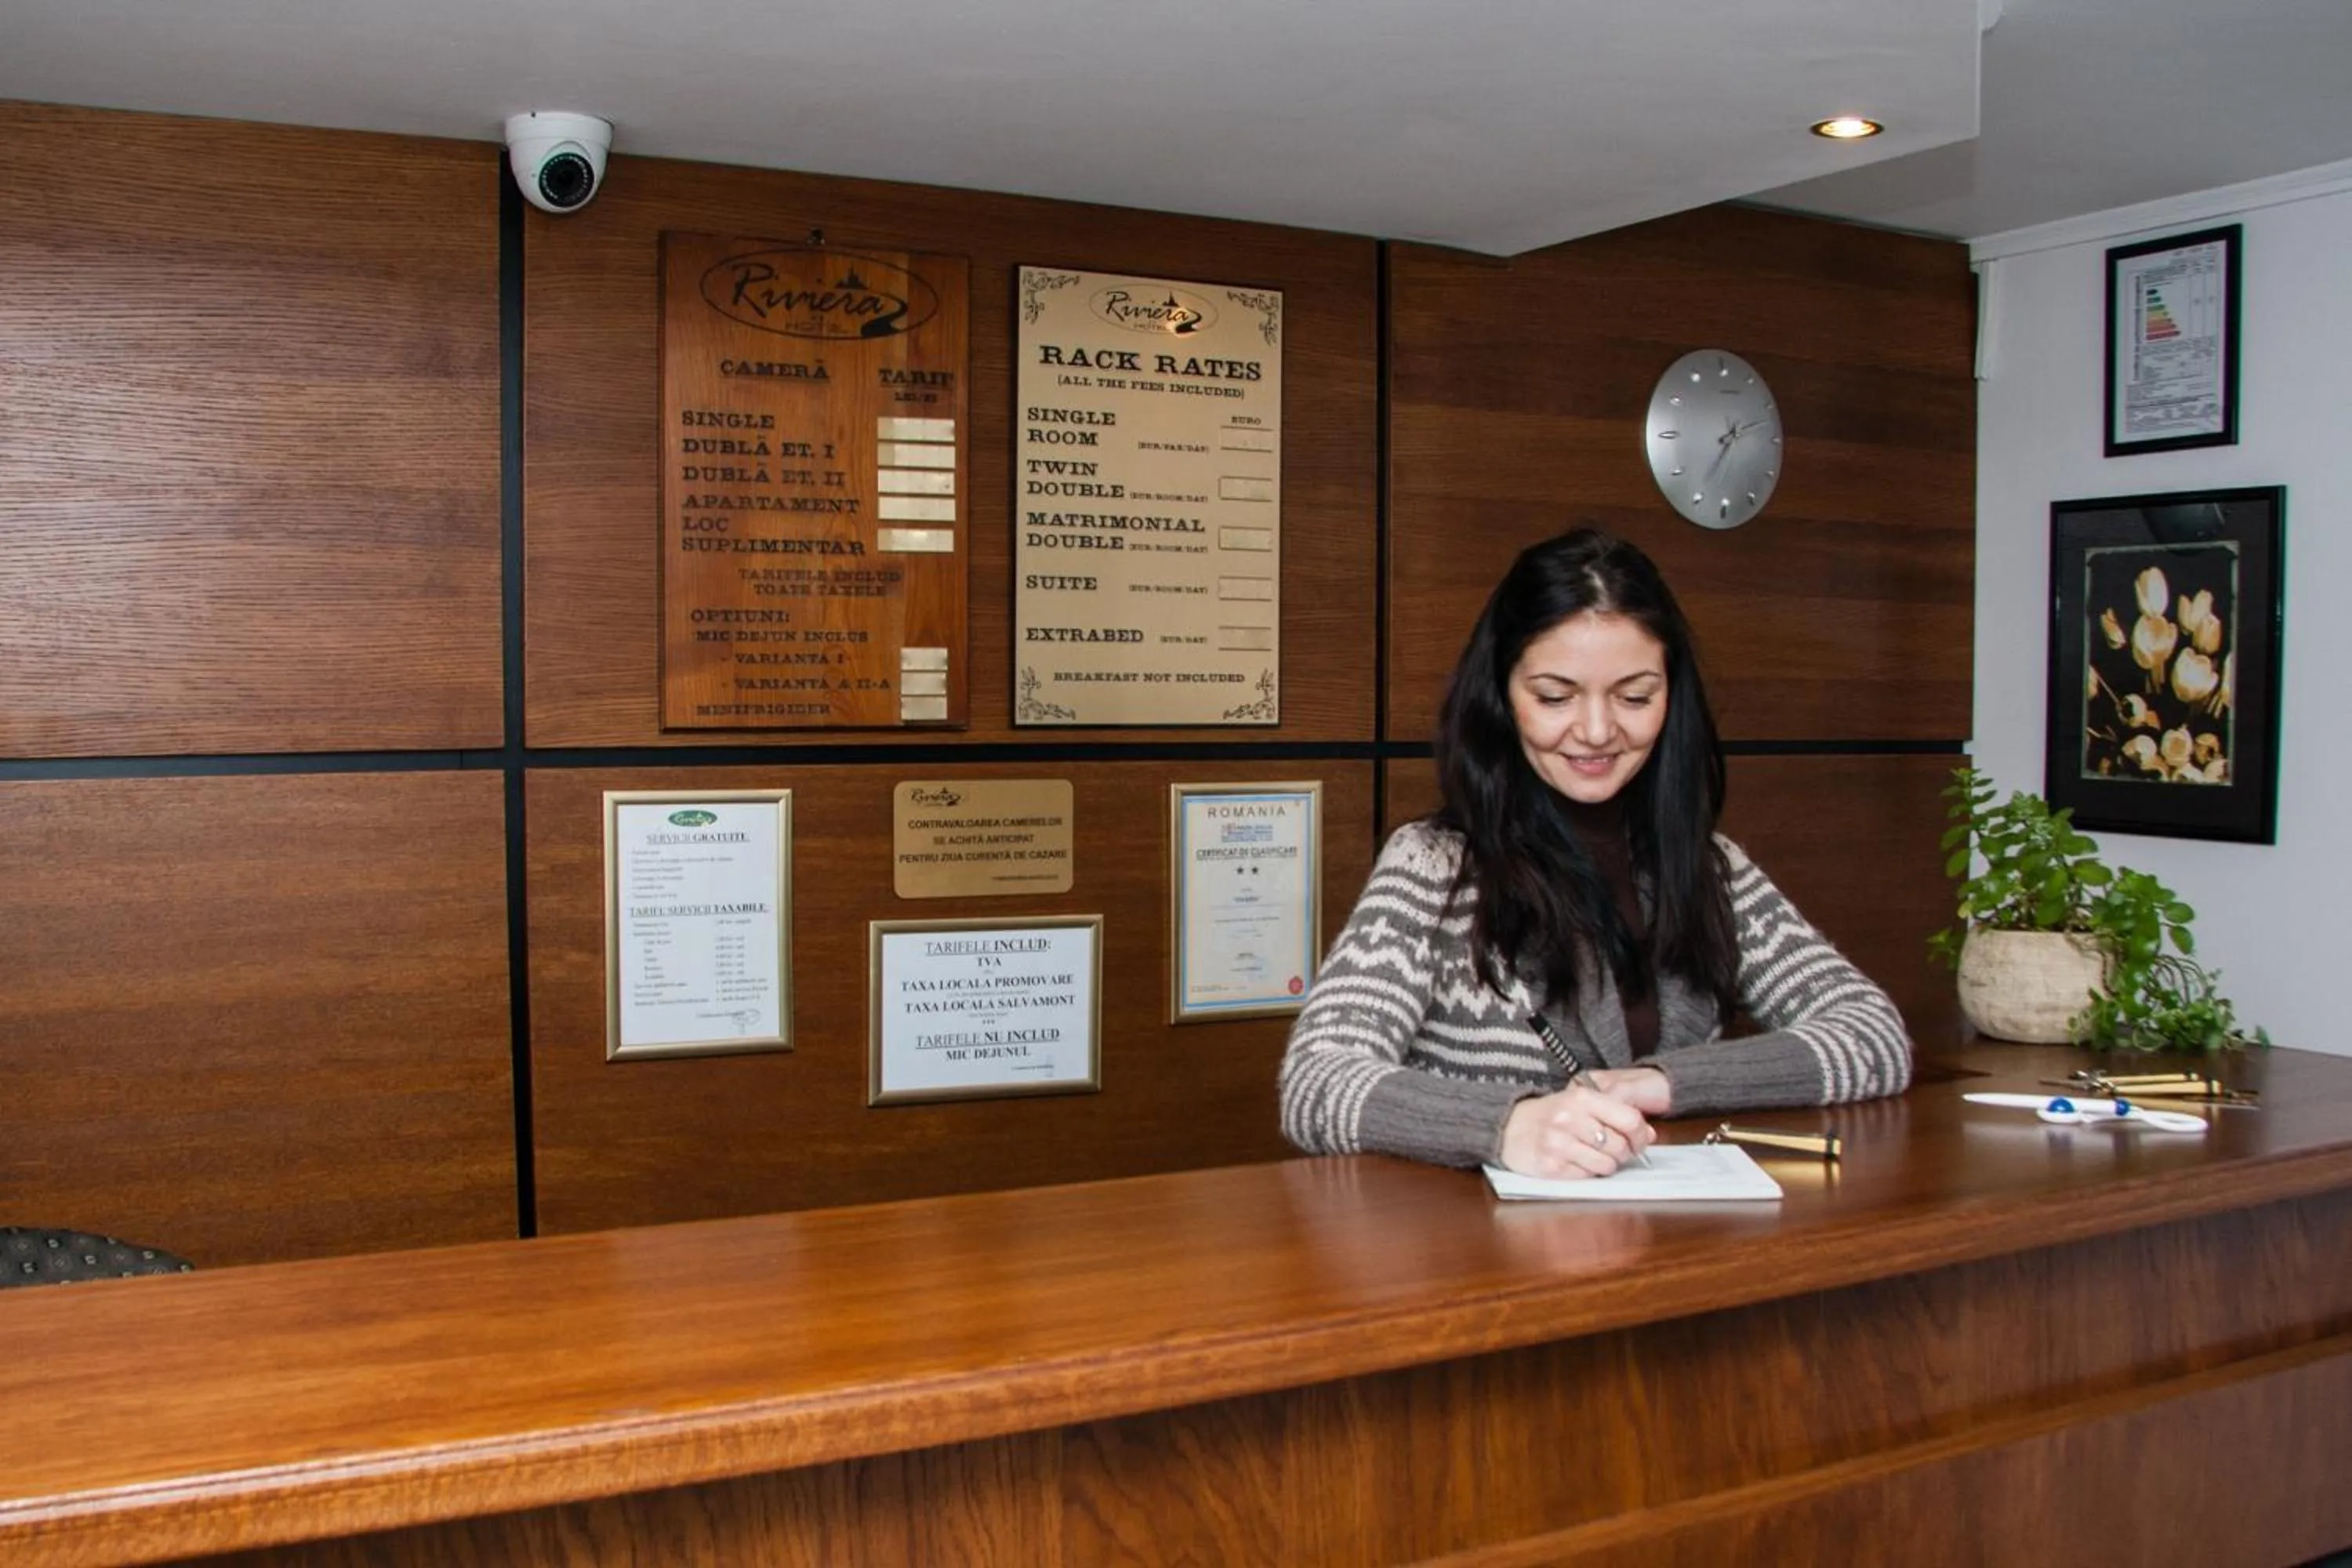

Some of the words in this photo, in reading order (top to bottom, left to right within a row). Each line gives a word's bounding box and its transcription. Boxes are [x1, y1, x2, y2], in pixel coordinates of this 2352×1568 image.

[731, 262, 886, 318] Riviera
[1105, 291, 1189, 322] Riviera
[1039, 344, 1142, 372] RACK
[1154, 354, 1262, 382] RATES
[878, 368, 954, 386] TARIF
[1057, 373, 1092, 388] (ALL
[1097, 377, 1127, 390] THE
[1131, 380, 1165, 393] FEES
[1169, 383, 1245, 399] INCLUDED)
[681, 410, 775, 429] SINGLE
[1027, 406, 1116, 426] SINGLE
[1231, 416, 1262, 426] EURO
[1027, 429, 1098, 446] ROOM
[682, 434, 771, 456] DUBLĂ
[781, 442, 815, 458] ET.
[823, 445, 835, 459] I
[682, 462, 771, 484] DUBLĂ
[781, 470, 816, 485] ET.
[822, 470, 845, 485] II
[1027, 459, 1098, 476] TWIN
[1027, 480, 1124, 499] DOUBLE
[683, 494, 860, 514] APARTAMENT
[683, 517, 729, 532] LOC
[1026, 512, 1206, 532] MATRIMONIAL
[681, 536, 866, 556] SUPLIMENTAR
[1026, 532, 1124, 550] DOUBLE
[738, 568, 828, 582] TARIFELE
[833, 569, 903, 583] INCLUD
[1025, 575, 1098, 590] SUITE
[753, 583, 811, 596] TOATE
[818, 584, 887, 597] TAXELE
[696, 630, 731, 642] MIC
[735, 630, 797, 643] DEJUN
[804, 630, 869, 643] INCLUS
[1025, 627, 1145, 643] EXTRABED
[1053, 672, 1138, 682] BREAKFAST
[1142, 673, 1172, 683] NOT
[1176, 673, 1246, 683] INCLUDED
[1207, 806, 1286, 818] ROMANIA
[908, 818, 1001, 829] CONTRAVALOAREA
[985, 833, 1035, 844] ANTICIPAT
[899, 852, 939, 863] PENTRU
[941, 852, 964, 862] ZIUA
[1014, 851, 1026, 860] DE
[1028, 850, 1067, 860] CAZARE
[1240, 846, 1249, 856] DE
[925, 941, 989, 955] TARIFELE
[977, 956, 1002, 967] TVA
[902, 981, 936, 992] TAXA
[939, 978, 992, 991] LOCALA
[994, 974, 1074, 988] PROMOVARE
[905, 1002, 939, 1014] TAXA
[942, 999, 995, 1011] LOCALA
[998, 994, 1076, 1008] SALVAMONT
[916, 1034, 980, 1048] TARIFELE
[984, 1030, 1003, 1043] NU
[1007, 1028, 1060, 1042] INCLUD
[946, 1050, 971, 1062] MIC
